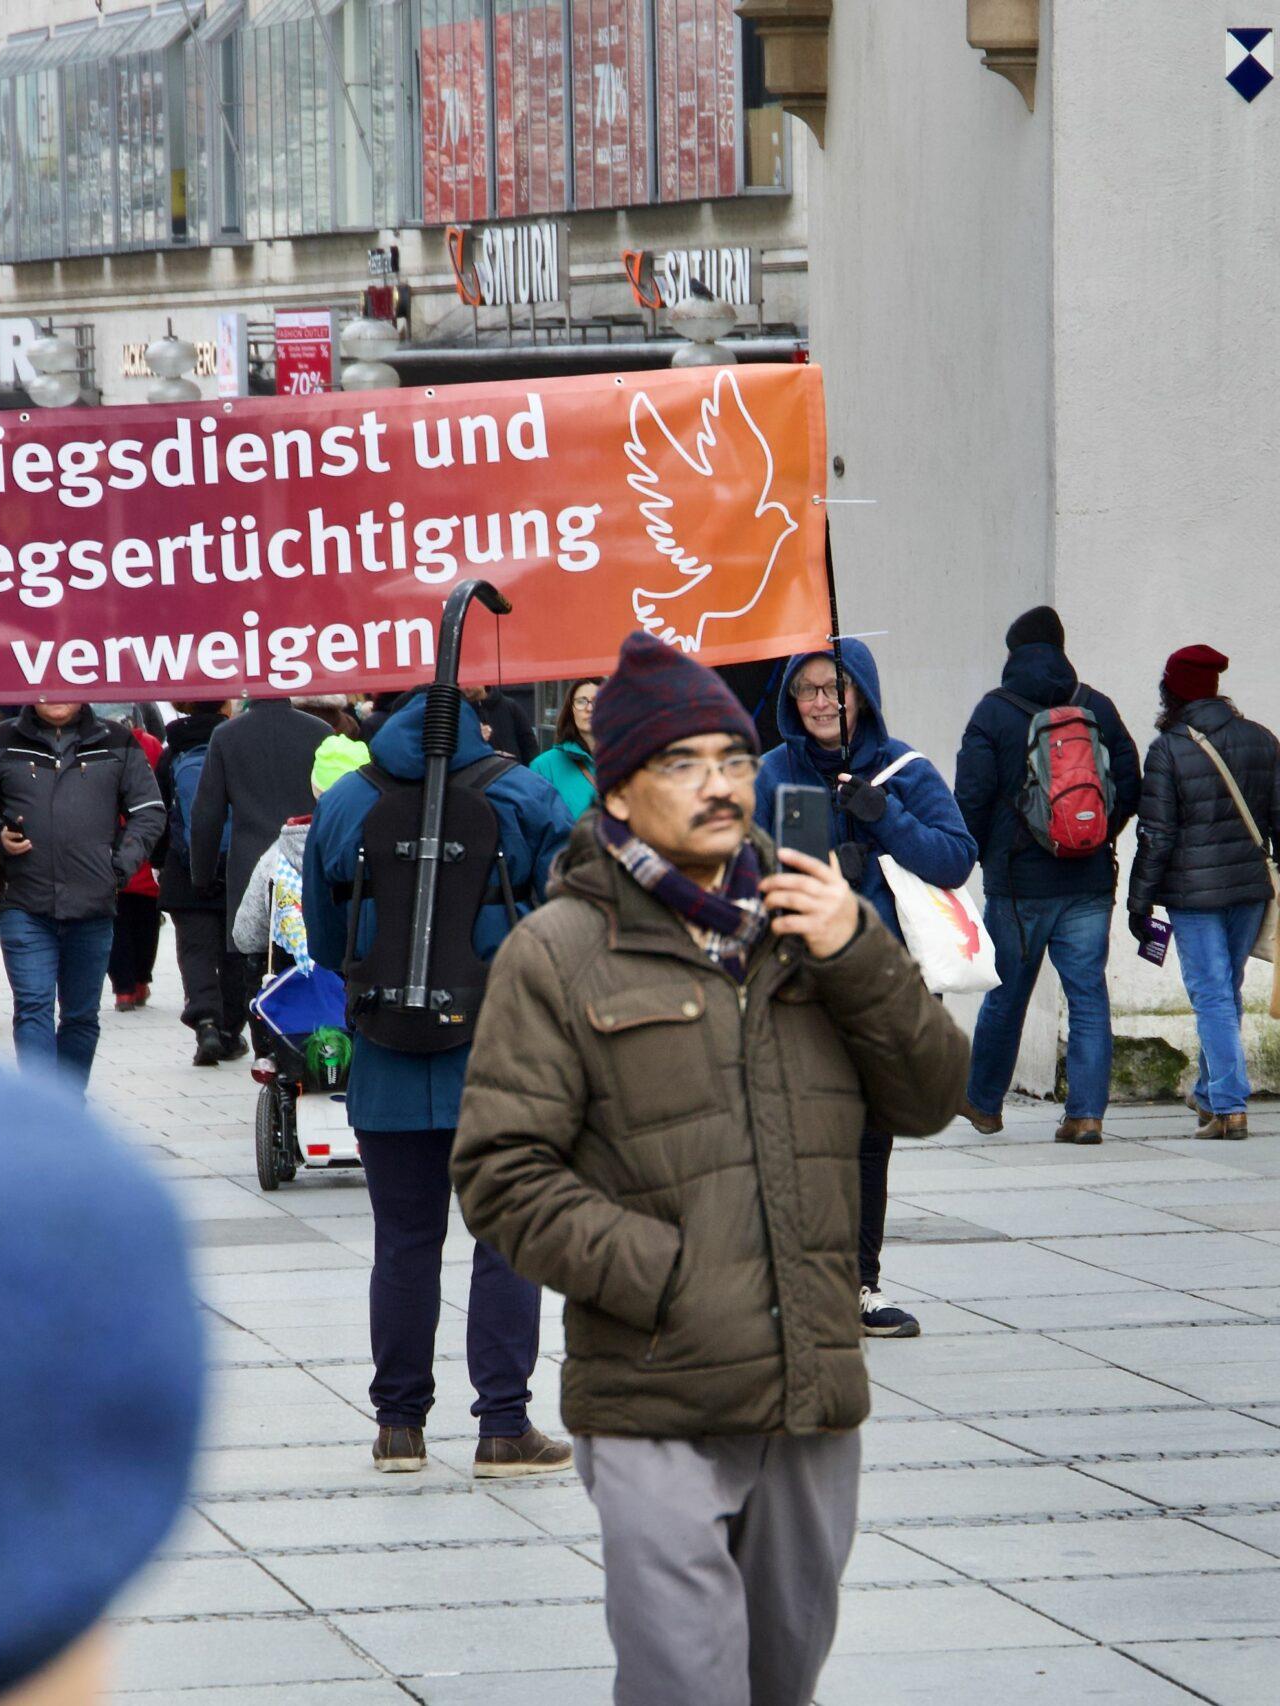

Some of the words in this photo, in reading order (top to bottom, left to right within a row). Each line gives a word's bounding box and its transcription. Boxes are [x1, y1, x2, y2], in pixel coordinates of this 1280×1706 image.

[482, 223, 559, 306] SATURN
[664, 247, 751, 308] SATURN
[304, 328, 329, 338] OUTLET
[412, 392, 549, 470] und
[10, 602, 447, 691] verweigern
